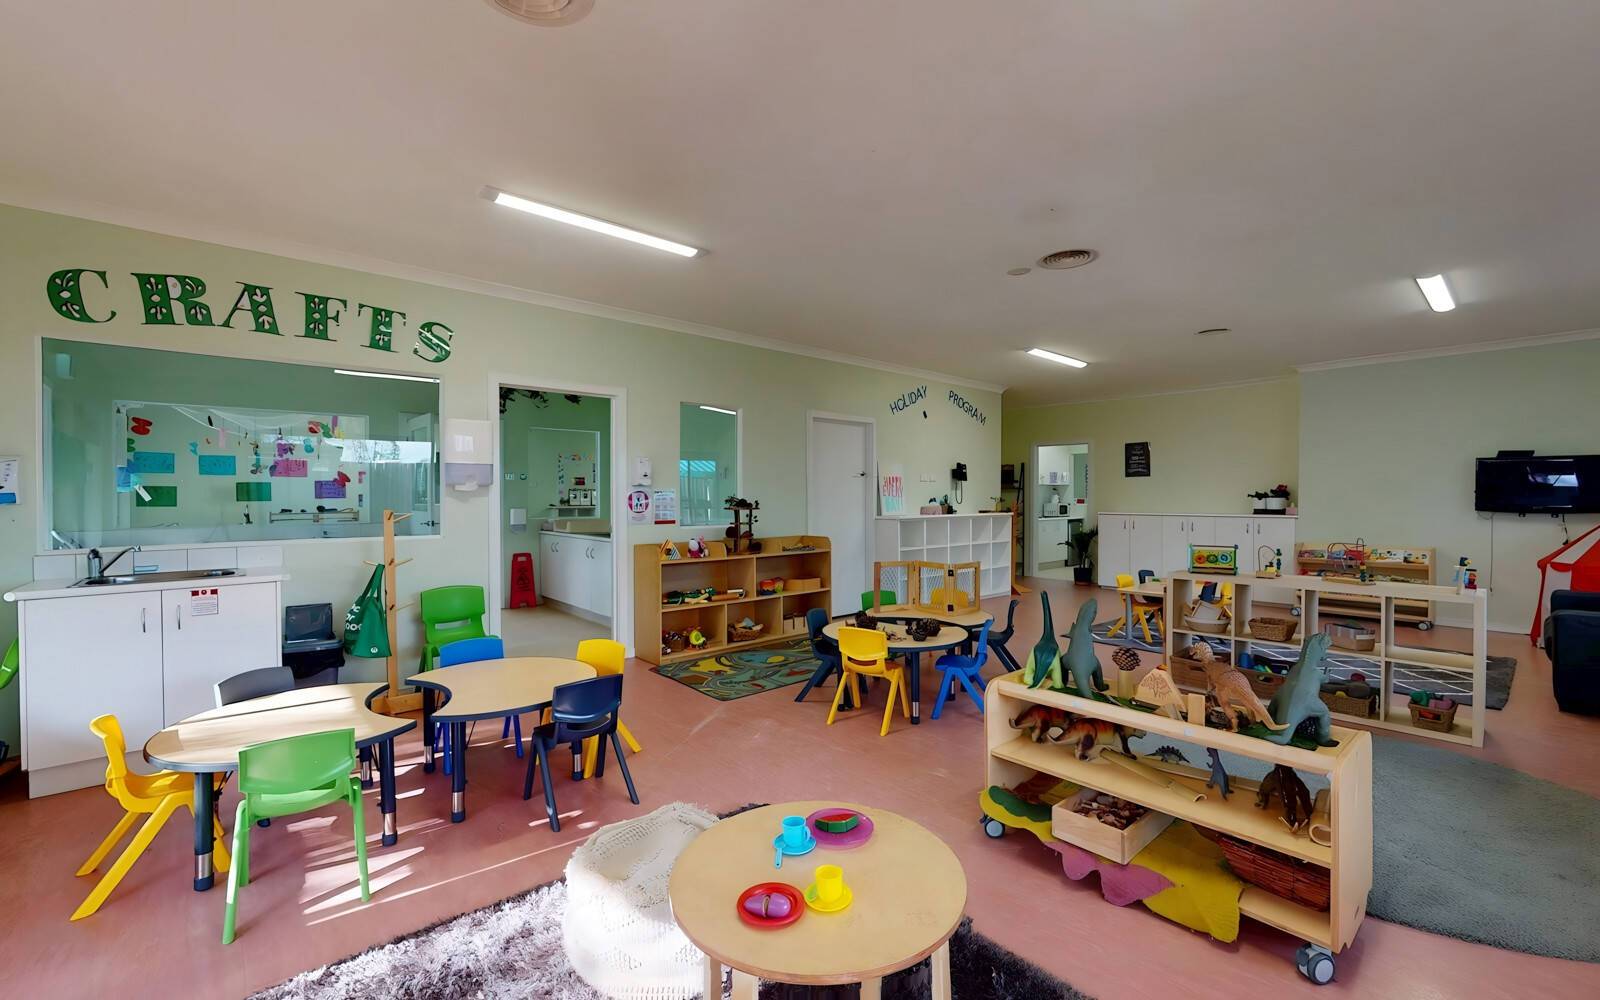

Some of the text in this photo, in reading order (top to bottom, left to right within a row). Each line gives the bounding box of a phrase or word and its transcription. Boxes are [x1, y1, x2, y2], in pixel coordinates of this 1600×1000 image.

[46, 268, 454, 363] CRAFTS
[889, 385, 986, 426] HOLIDAY PROGRAM
